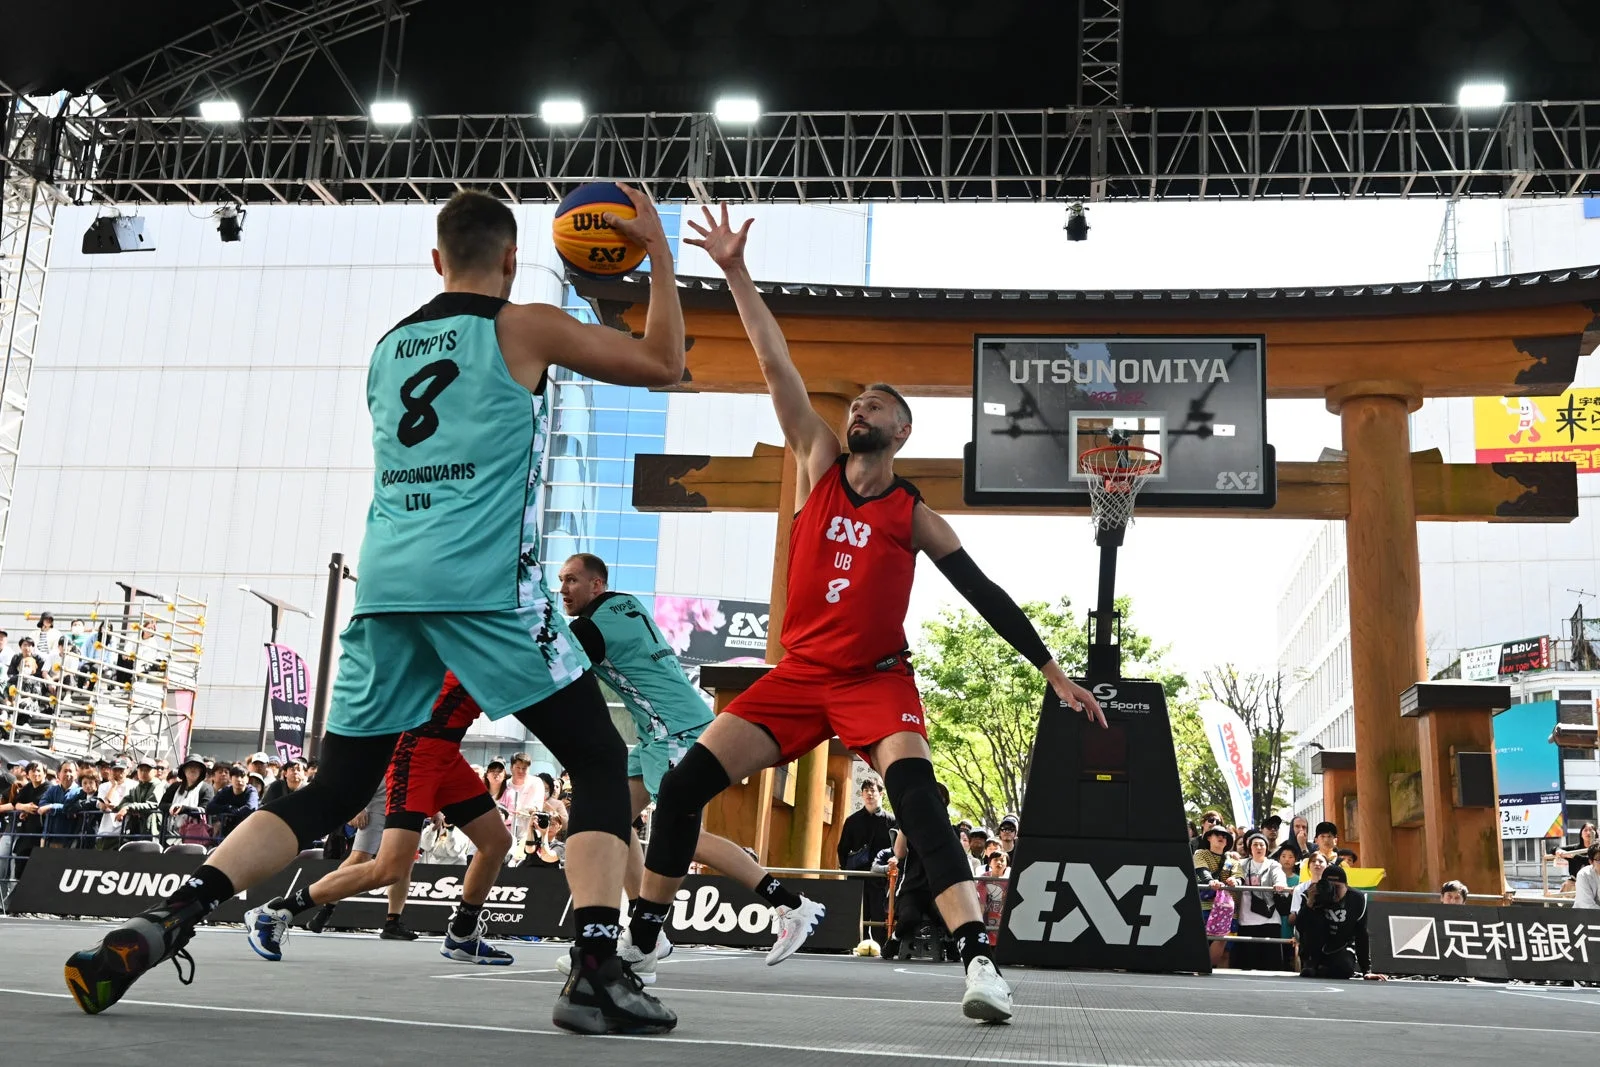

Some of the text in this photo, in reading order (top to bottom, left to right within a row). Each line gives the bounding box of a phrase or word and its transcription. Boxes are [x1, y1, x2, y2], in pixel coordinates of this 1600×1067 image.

[394, 330, 457, 359] KUMPYS
[1009, 358, 1230, 384] UTSUNOMIYA
[397, 358, 460, 448] 8
[405, 492, 431, 512] LTU
[834, 551, 853, 571] UB
[825, 578, 850, 604] 8
[625, 610, 659, 644] 7
[730, 639, 752, 647] WORLD
[1110, 701, 1150, 711] Sports
[490, 912, 523, 923] GROUP
